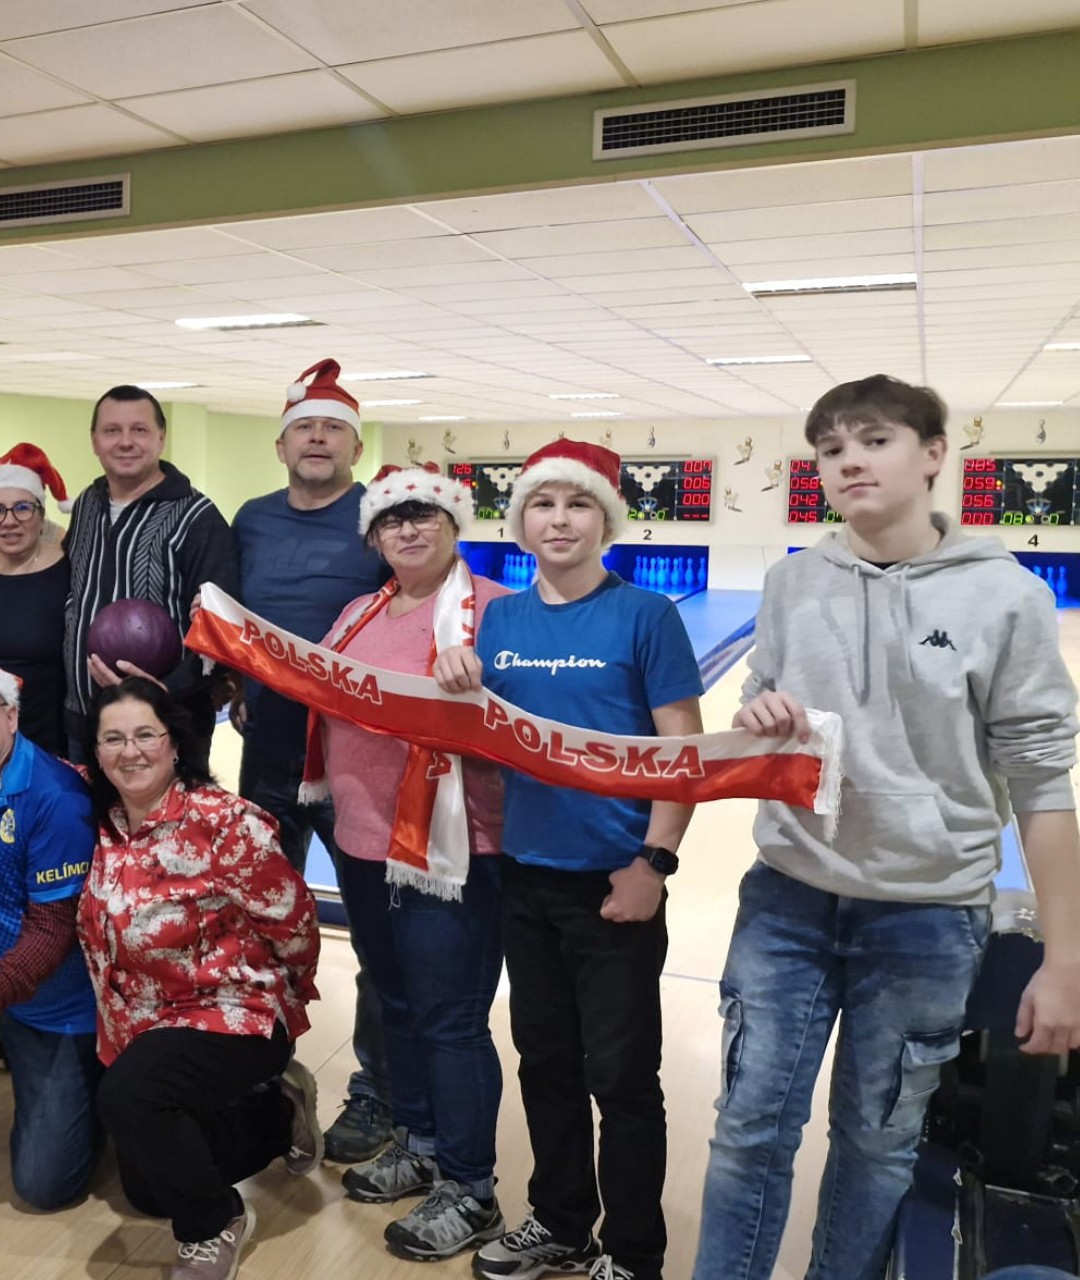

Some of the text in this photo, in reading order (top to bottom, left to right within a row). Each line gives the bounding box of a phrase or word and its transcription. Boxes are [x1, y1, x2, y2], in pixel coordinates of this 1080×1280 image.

[683, 477, 710, 490] 006
[682, 493, 710, 506] 000
[789, 493, 819, 506] 042
[497, 527, 504, 538] 1
[642, 528, 653, 541] 2
[1027, 534, 1040, 548] 4
[240, 617, 384, 707] POLSKA
[493, 649, 607, 675] Champion
[482, 697, 707, 780] POLSKA
